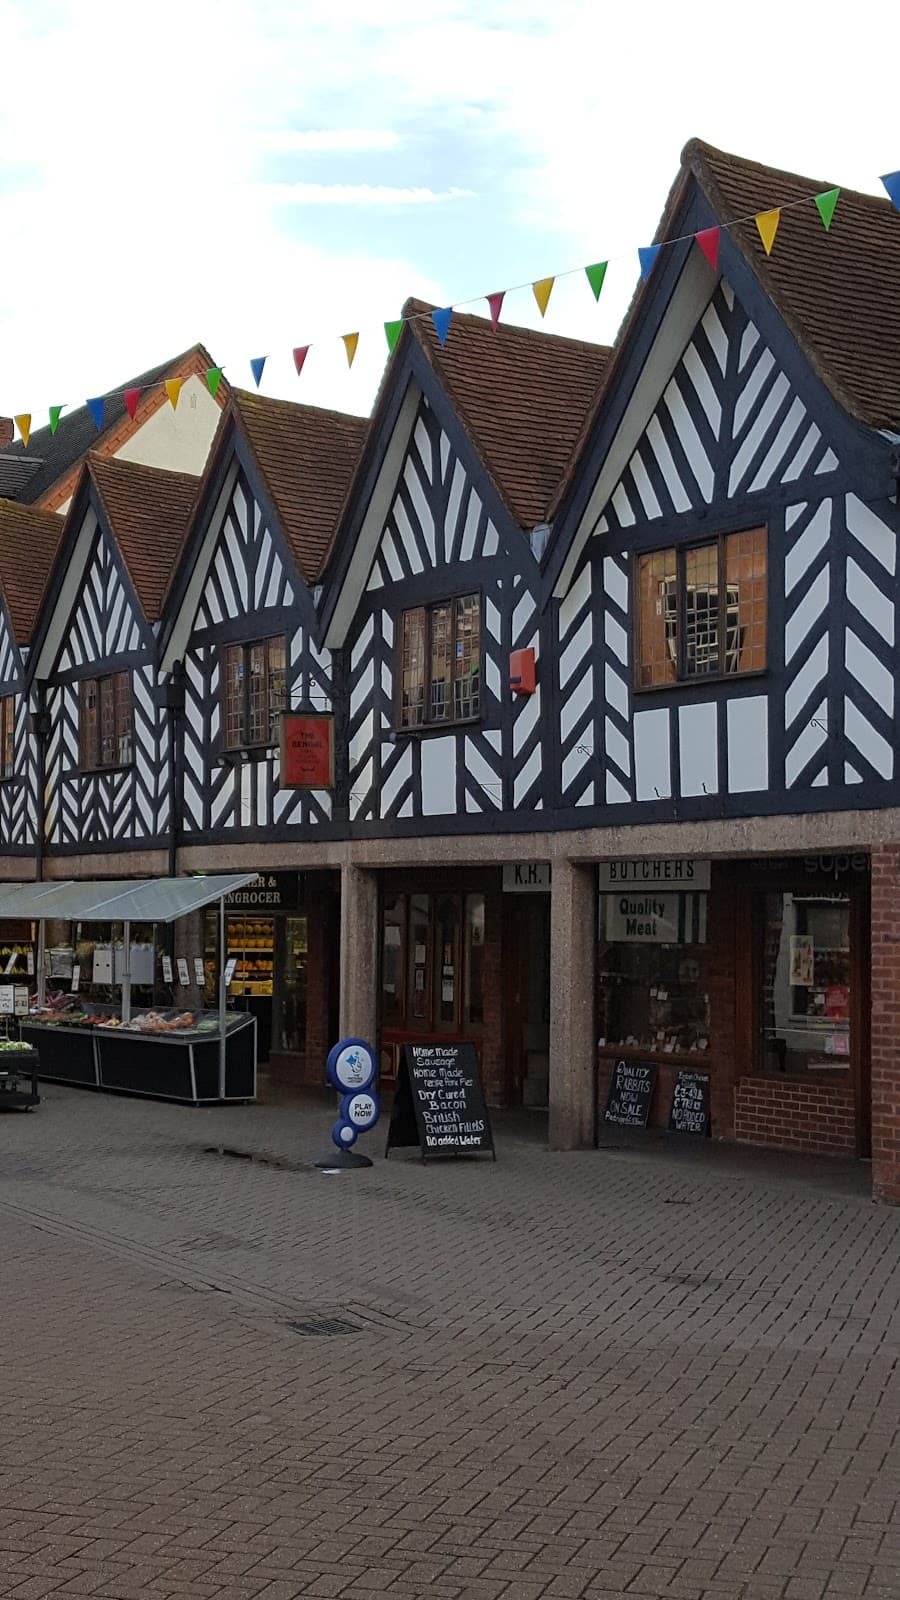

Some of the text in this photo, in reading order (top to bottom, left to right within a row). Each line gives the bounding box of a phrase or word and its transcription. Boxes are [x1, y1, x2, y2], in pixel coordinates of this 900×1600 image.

[610, 860, 695, 879] BUTCHERS
[803, 855, 870, 880] supe
[267, 875, 277, 888] &
[619, 898, 665, 917] Quality
[625, 918, 658, 936] Meat
[416, 1057, 456, 1068] Sausage
[615, 1075, 651, 1093] RABBITS
[437, 1088, 466, 1100] Cured
[619, 1091, 639, 1102] NOW
[428, 1100, 467, 1110] Bacon
[620, 1101, 643, 1116] SALE
[422, 1111, 461, 1124] British
[671, 1108, 683, 1120] NO
[426, 1123, 458, 1134] Chicken
[437, 1135, 459, 1146] added
